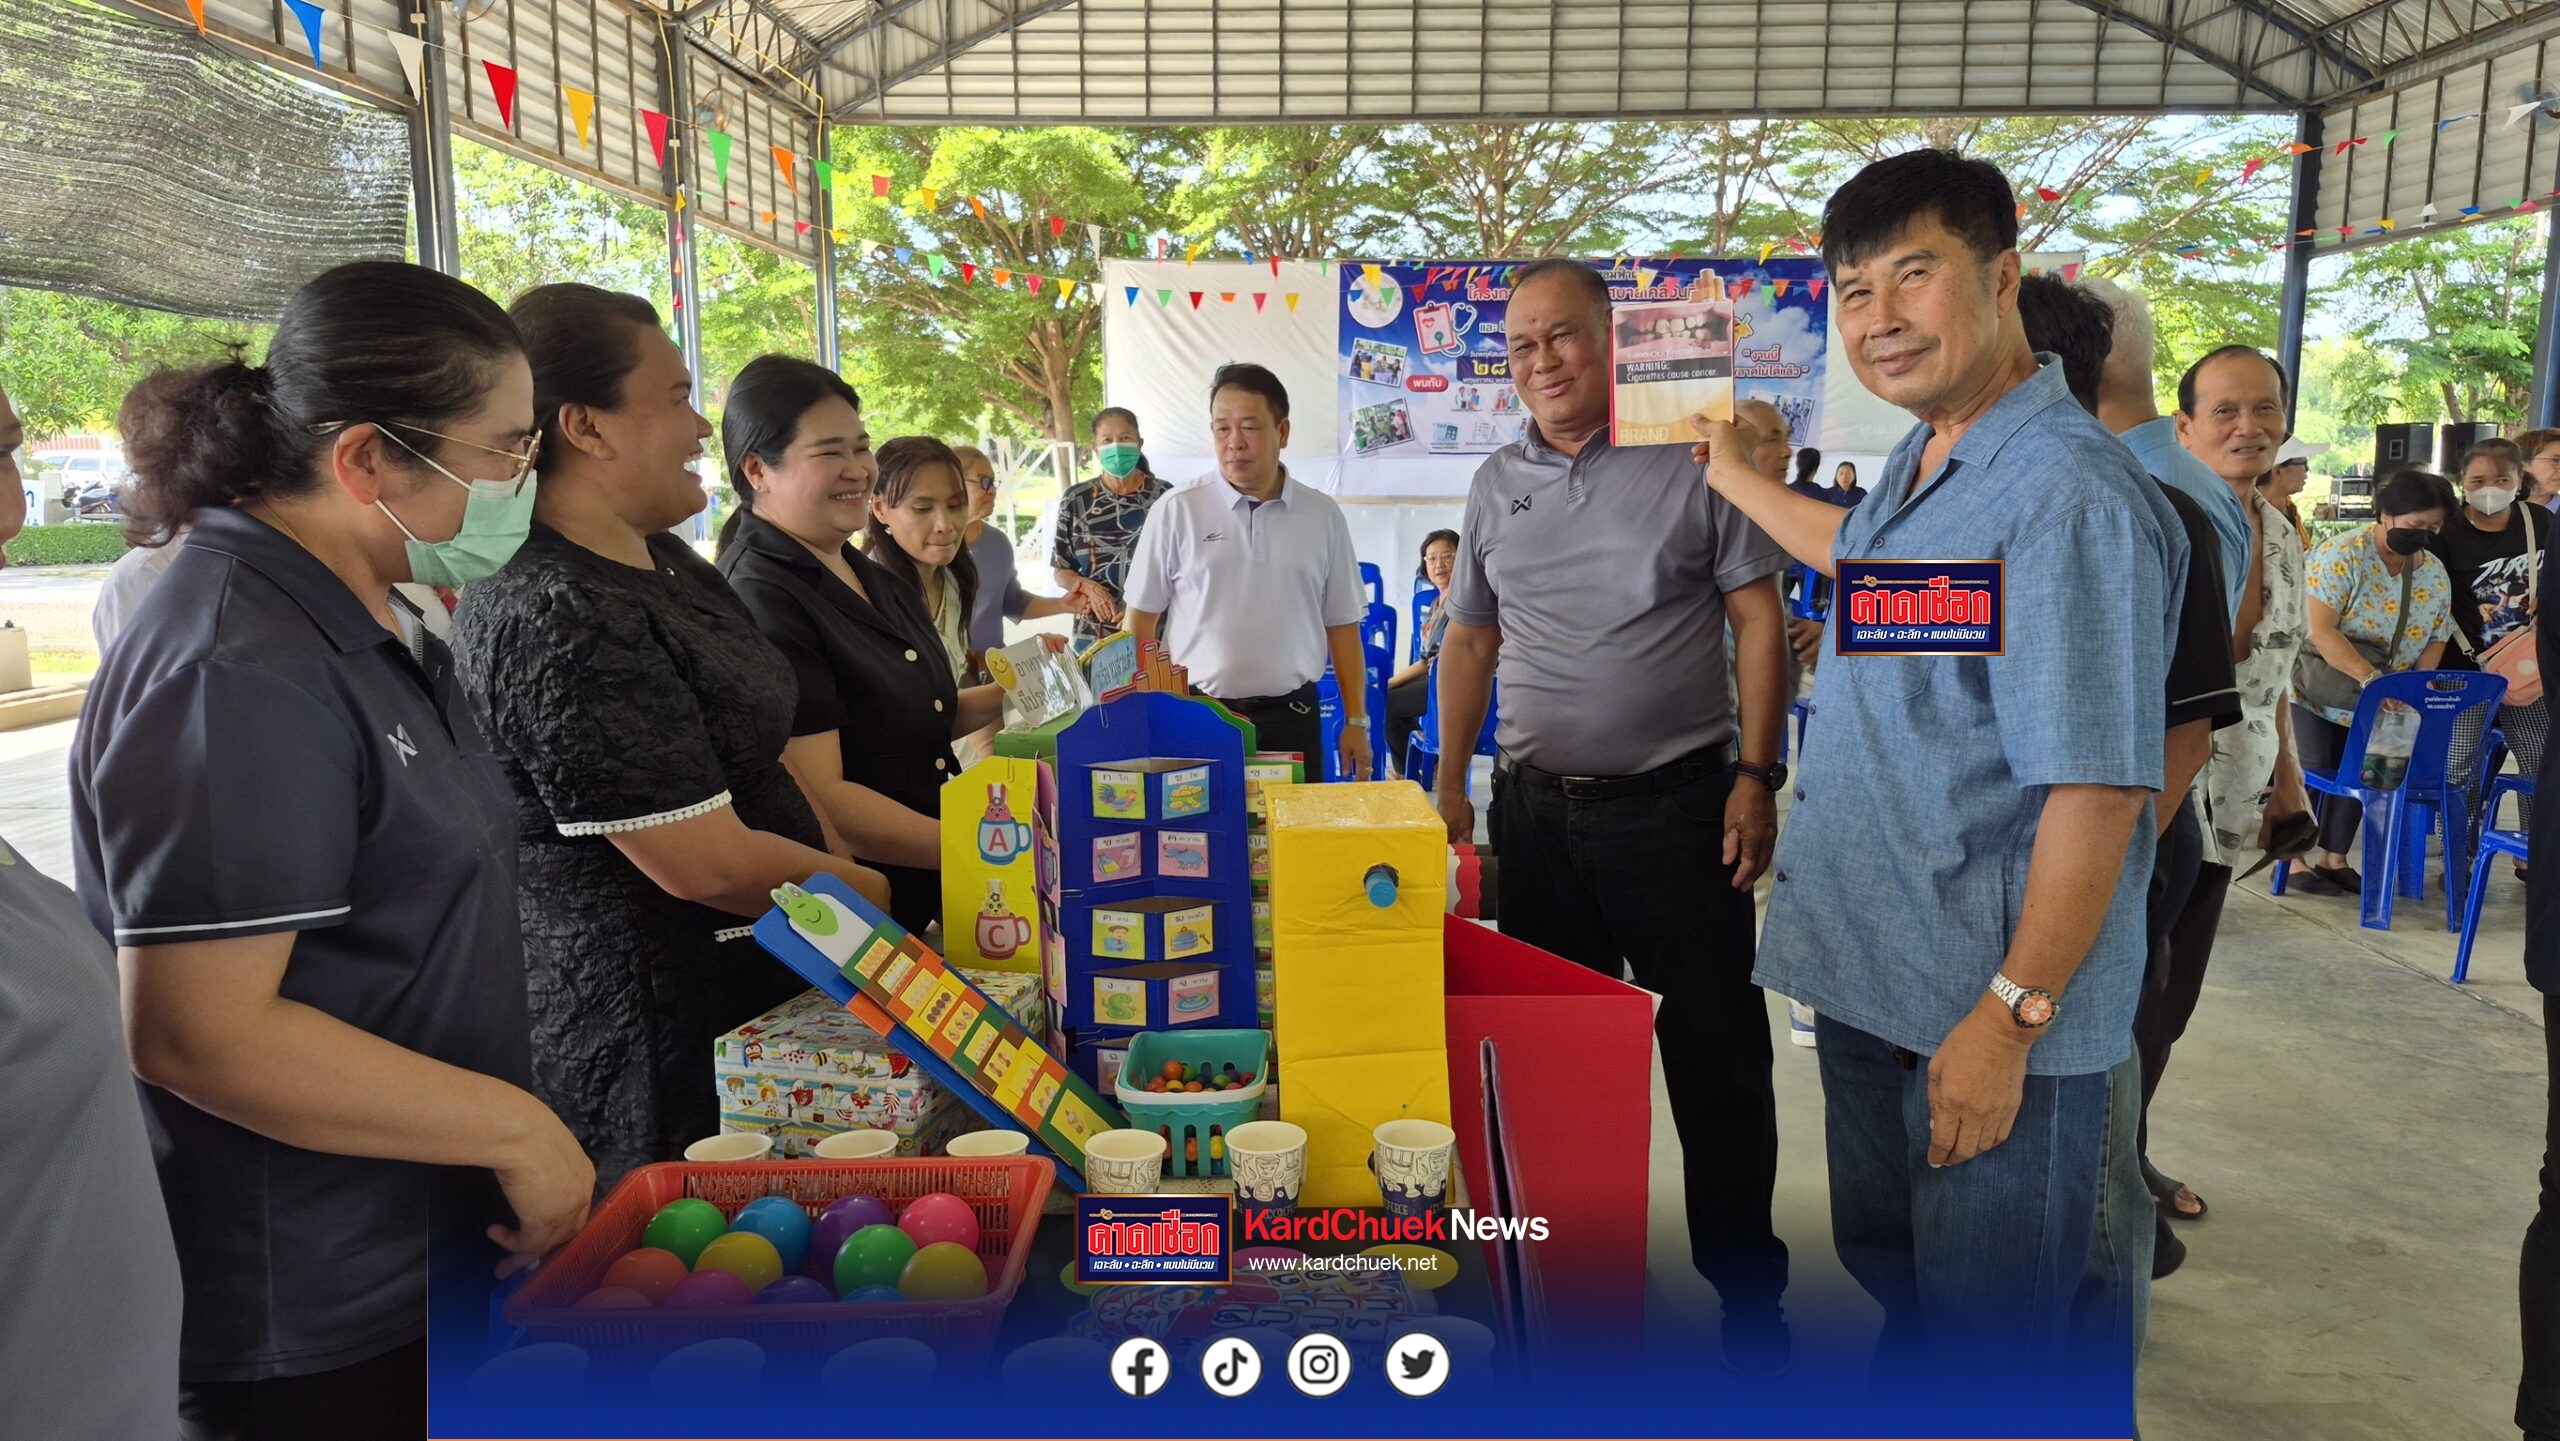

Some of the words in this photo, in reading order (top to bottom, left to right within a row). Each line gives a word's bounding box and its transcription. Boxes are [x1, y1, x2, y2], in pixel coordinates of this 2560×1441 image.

[1626, 361, 1670, 373] WARNING:
[1627, 371, 1666, 384] Cigarettes
[1667, 370, 1690, 380] cause
[1691, 367, 1719, 378] cancer.
[1620, 427, 1669, 443] BRAND
[989, 827, 1008, 852] A
[988, 925, 1006, 948] C
